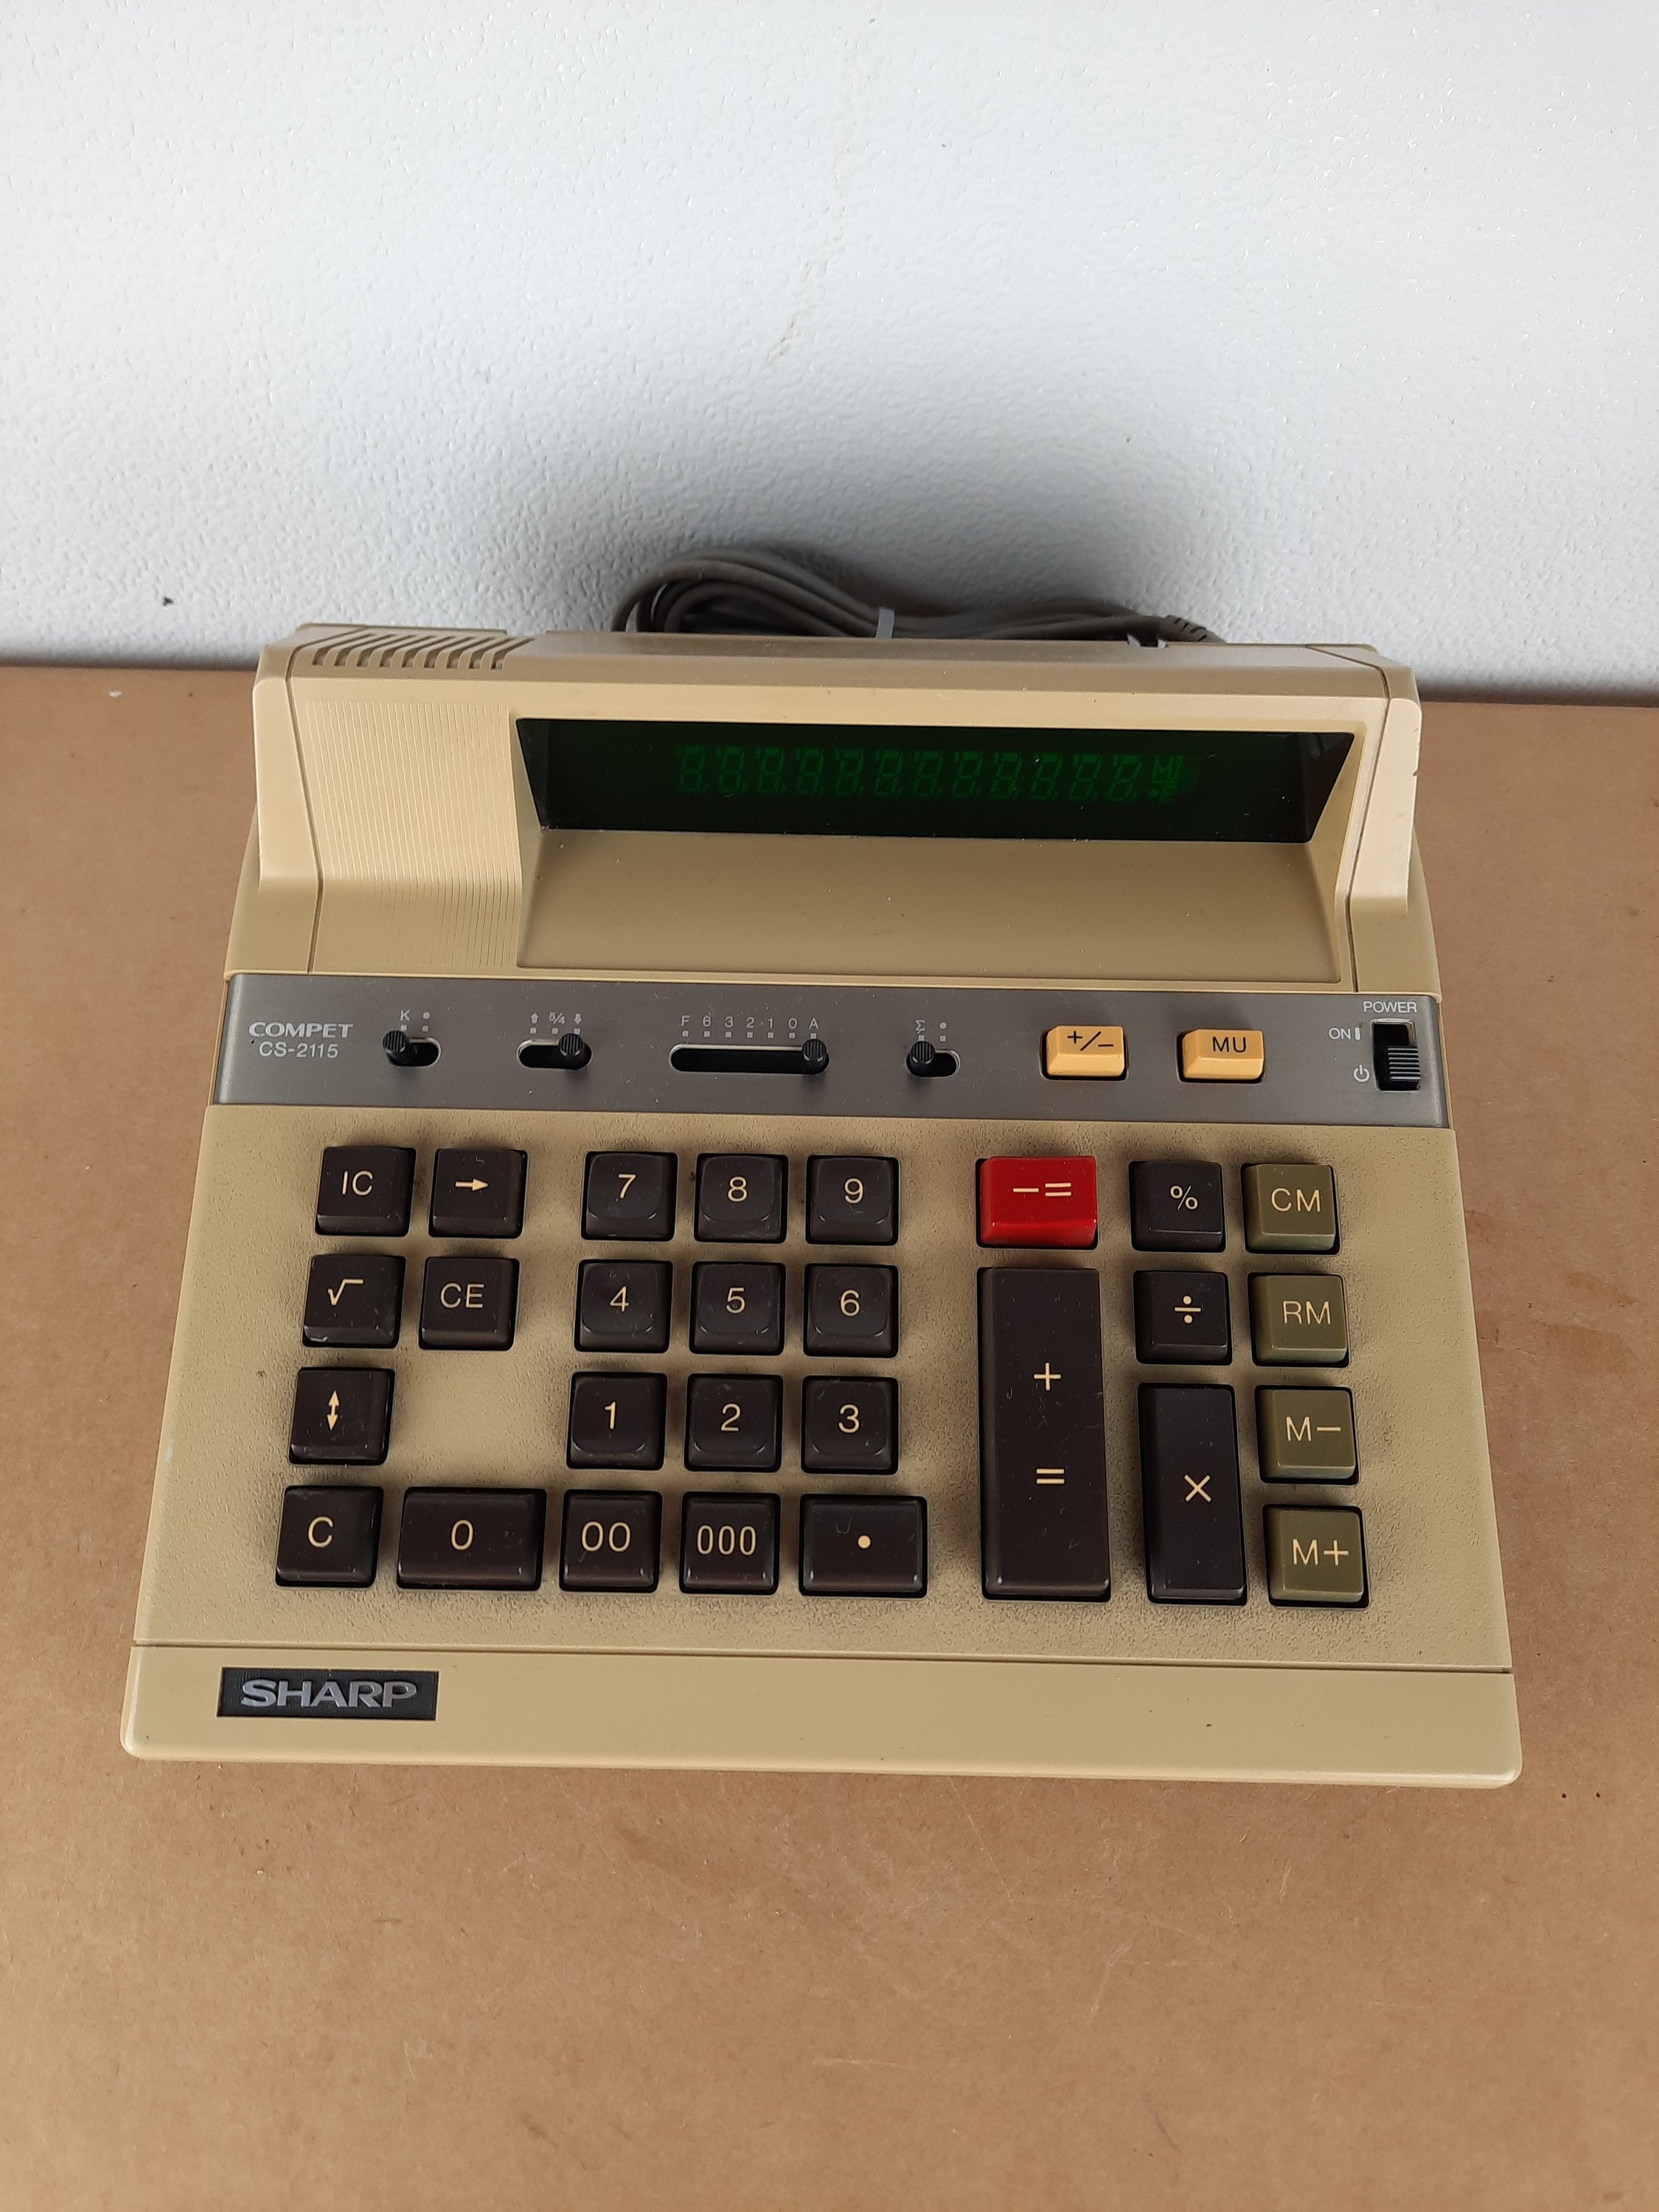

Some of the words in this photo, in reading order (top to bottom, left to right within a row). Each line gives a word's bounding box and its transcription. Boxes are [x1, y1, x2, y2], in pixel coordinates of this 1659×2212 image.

[400, 1009, 410, 1021] K
[1363, 1001, 1417, 1013] POWER
[248, 1023, 353, 1038] COMPET
[681, 1015, 690, 1027] F
[703, 1017, 712, 1029] 6
[725, 1017, 733, 1029] 3
[747, 1017, 754, 1029] 2
[768, 1017, 773, 1029] 1
[809, 1018, 819, 1029] A
[1329, 1027, 1351, 1040] ON
[259, 1042, 338, 1058] CS-2115
[1213, 1037, 1247, 1053] MU
[341, 1170, 373, 1196] IC
[618, 1174, 636, 1199] 7
[728, 1177, 748, 1202] 8
[844, 1178, 863, 1203] 9
[1170, 1185, 1198, 1211] %
[1271, 1188, 1321, 1212] CM
[440, 1283, 484, 1308] CE
[610, 1286, 629, 1312] 4
[726, 1287, 745, 1313] 5
[841, 1290, 860, 1316] 6
[1283, 1301, 1332, 1324] RM
[604, 1401, 616, 1430] 1
[720, 1403, 740, 1432] 2
[838, 1404, 859, 1433] 3
[307, 1516, 333, 1547] C
[1293, 1539, 1349, 1566] M+
[240, 1678, 417, 1708] SHARP
